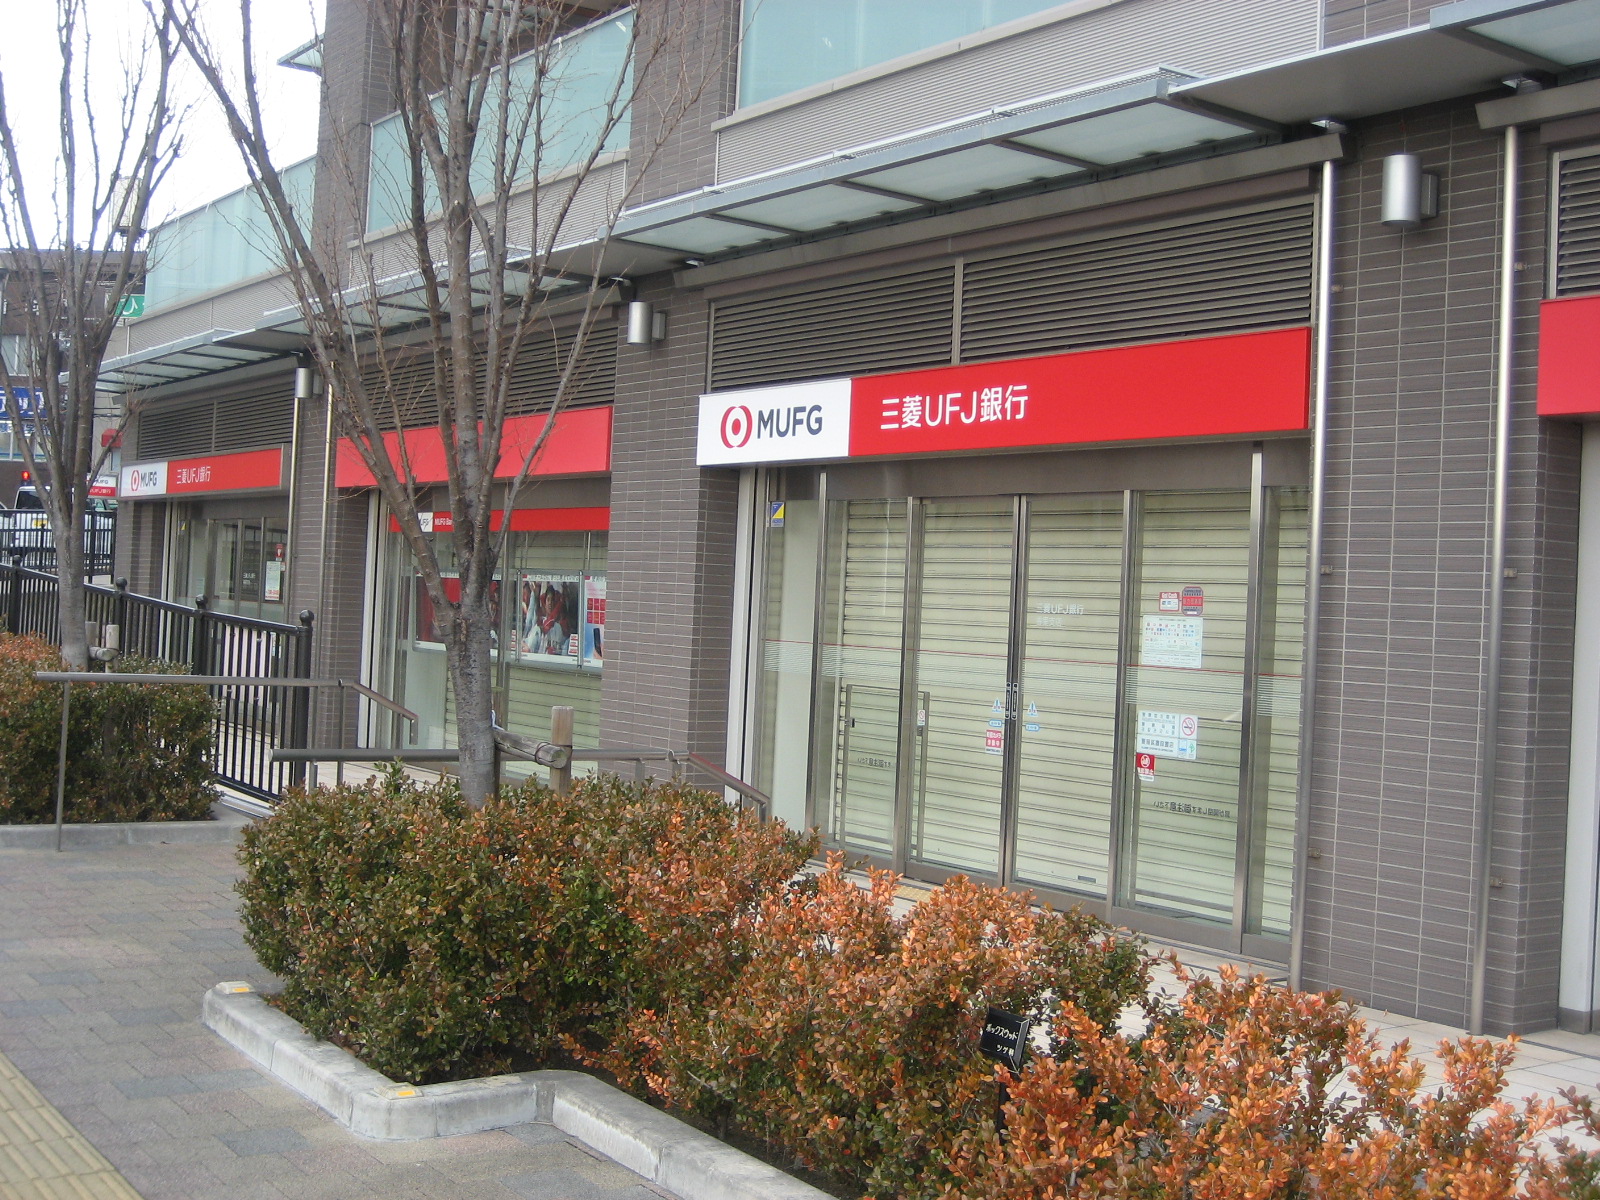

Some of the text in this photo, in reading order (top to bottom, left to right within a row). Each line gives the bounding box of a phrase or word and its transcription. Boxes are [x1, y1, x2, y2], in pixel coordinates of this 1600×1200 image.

[880, 385, 1029, 430] 三菱UFJ銀行
[757, 404, 823, 440] MUFG
[140, 471, 158, 487] MUFG
[176, 466, 211, 485] 三菱UFJ銀行
[985, 1023, 1019, 1041] ボックスウッド
